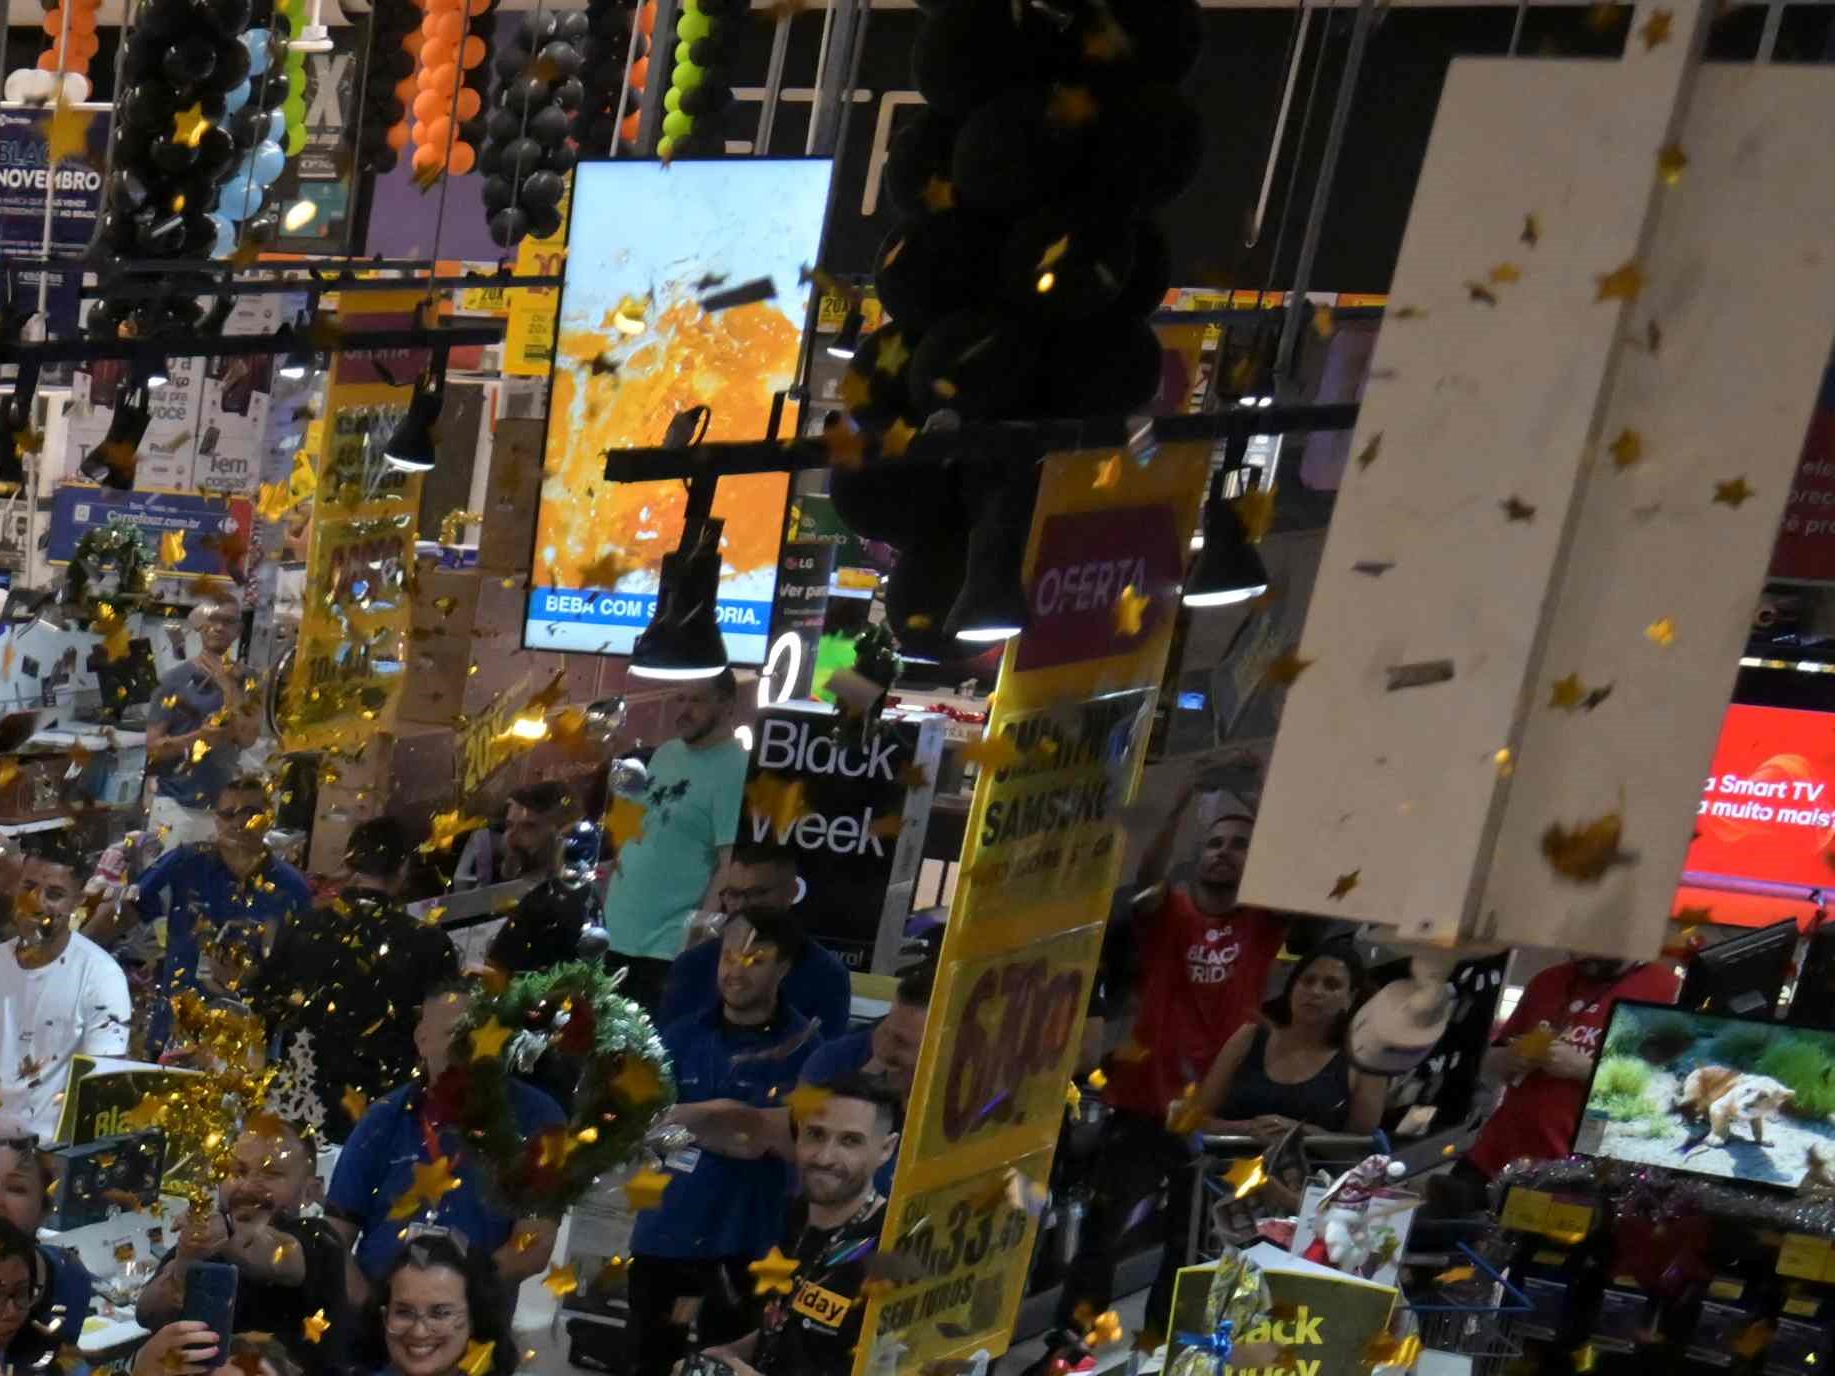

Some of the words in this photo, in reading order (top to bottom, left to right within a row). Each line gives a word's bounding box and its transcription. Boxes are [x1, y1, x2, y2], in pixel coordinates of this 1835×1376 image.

[1036, 556, 1146, 616] OFERTA
[545, 595, 595, 615] BEBA
[600, 600, 642, 617] COM
[757, 719, 900, 780] Black
[1720, 774, 1789, 799] Smart
[1791, 781, 1825, 802] TV
[1712, 799, 1775, 821] muito
